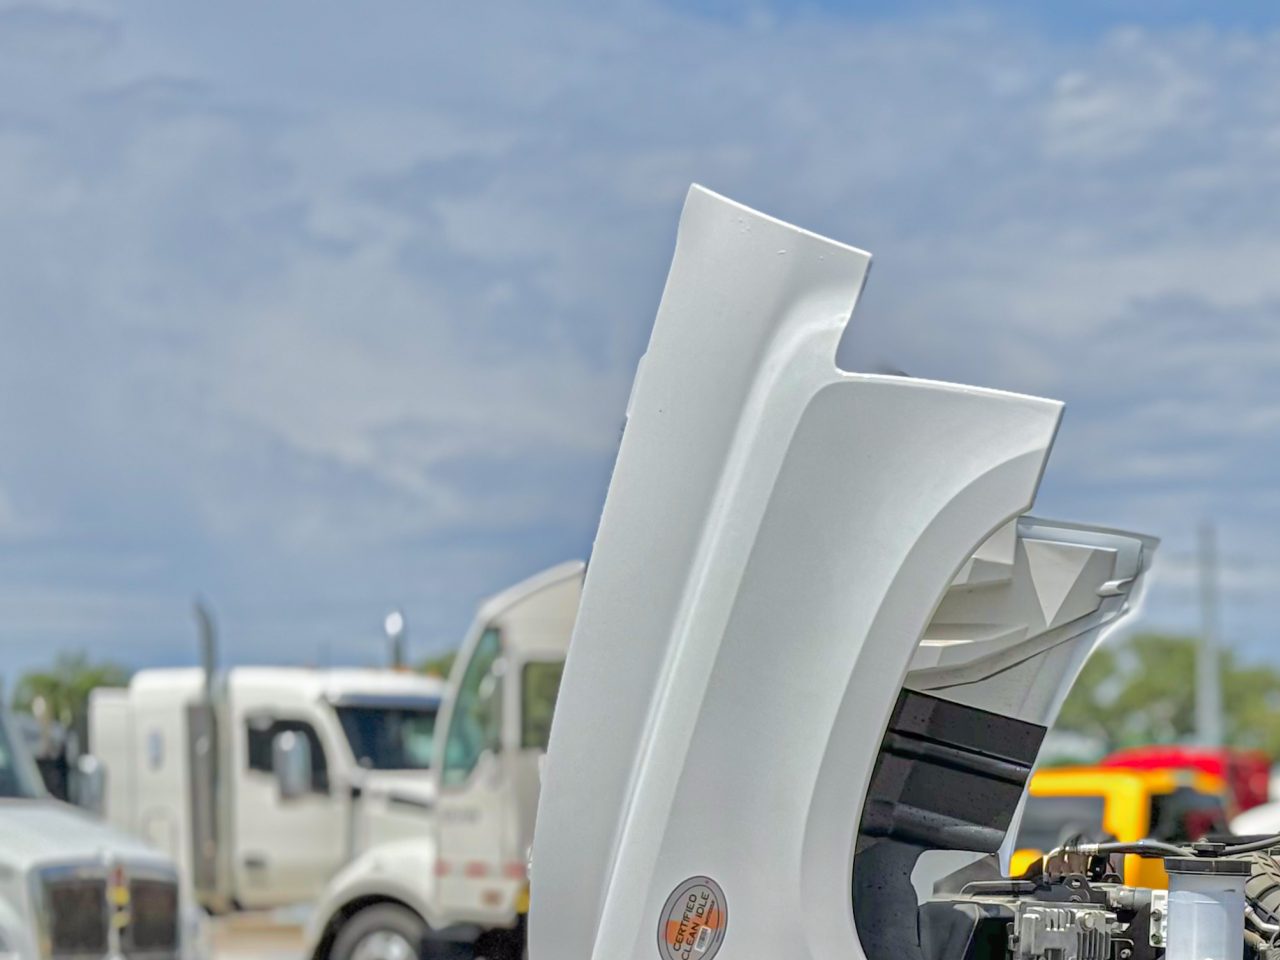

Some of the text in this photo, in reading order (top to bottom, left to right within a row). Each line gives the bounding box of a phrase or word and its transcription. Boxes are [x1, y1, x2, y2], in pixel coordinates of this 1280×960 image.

[673, 893, 698, 952] CERTIFIED
[681, 921, 700, 960] CLEAN
[695, 891, 710, 919] IDLE
